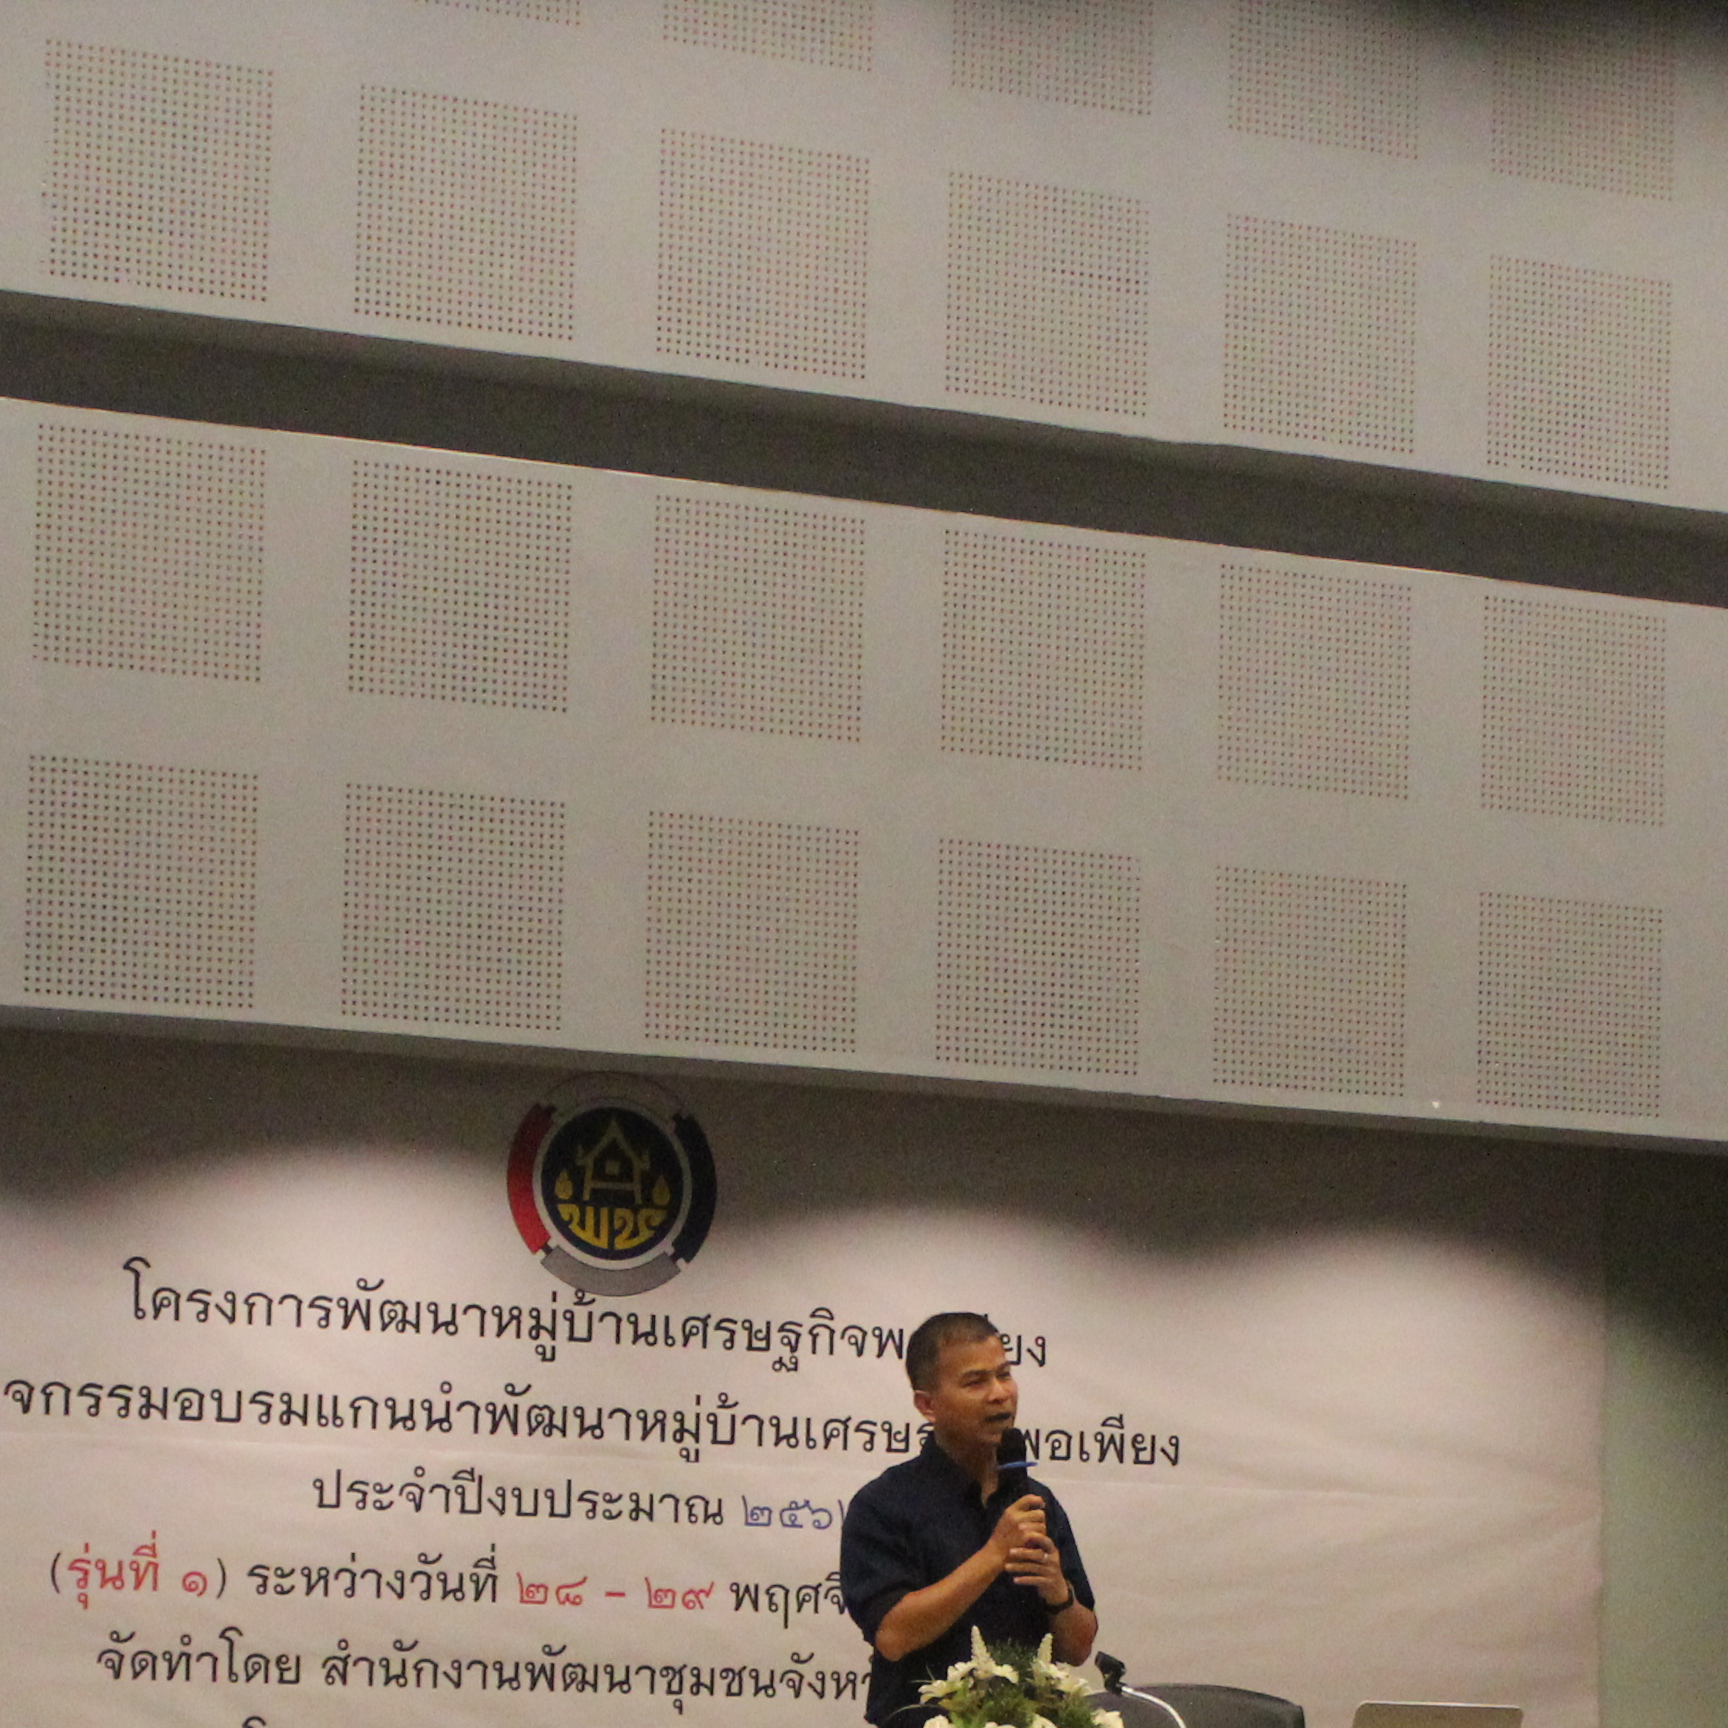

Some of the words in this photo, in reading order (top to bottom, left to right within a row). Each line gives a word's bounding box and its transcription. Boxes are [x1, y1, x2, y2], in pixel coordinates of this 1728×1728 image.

[122, 1256, 1047, 1373] โครงการพัฒนาหมู่บ้านเศรษฐกิจพยง
[313, 1466, 723, 1525] ประจำปีงบประมาณ
[742, 1494, 845, 1530] ๒๕๖
[51, 1531, 159, 1609] (รุ่นที่
[247, 1543, 498, 1603] ระหว่างวันที่
[645, 1577, 714, 1610] ๒๙
[97, 1626, 300, 1684] จัดทำโดย
[320, 1636, 872, 1716] สำนักงานพัฒนาชุมชนจังห
